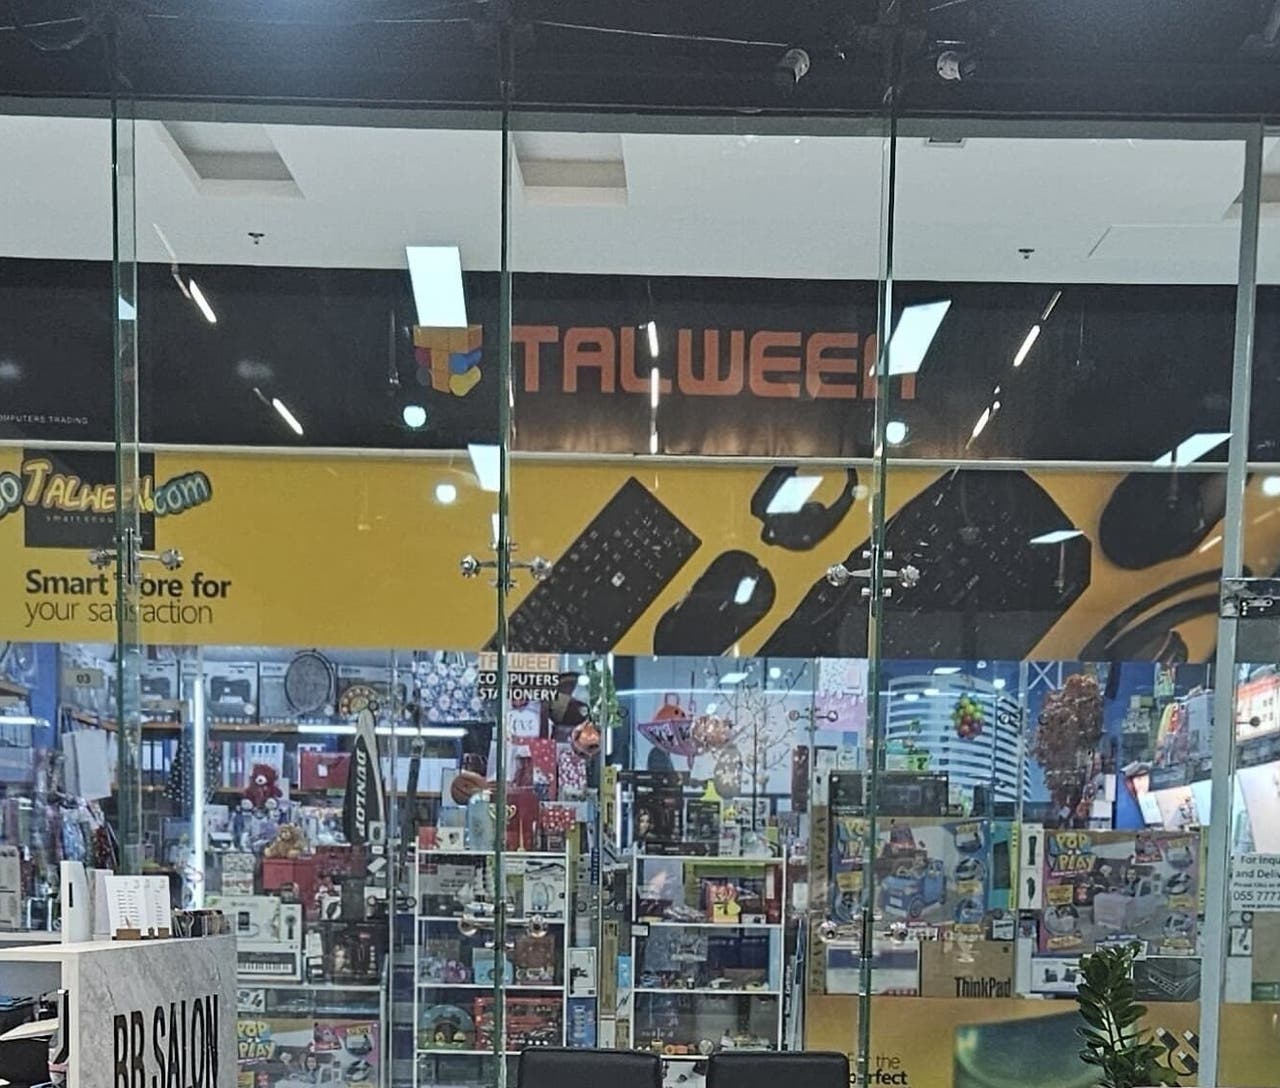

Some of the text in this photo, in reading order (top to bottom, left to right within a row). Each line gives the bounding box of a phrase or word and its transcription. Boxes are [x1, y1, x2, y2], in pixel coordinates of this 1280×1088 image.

[25, 569, 232, 599] Smart ore for
[25, 600, 213, 628] your saisaction
[478, 672, 560, 687] COPUTERS
[479, 687, 559, 701] STIONERY
[355, 747, 367, 838] DUNLOP
[1058, 854, 1097, 872] PLAY
[1240, 855, 1257, 865] For
[1235, 869, 1255, 879] and
[1233, 890, 1254, 901] 055
[954, 976, 1012, 999] ThinkPad
[848, 1068, 908, 1085] prfect
